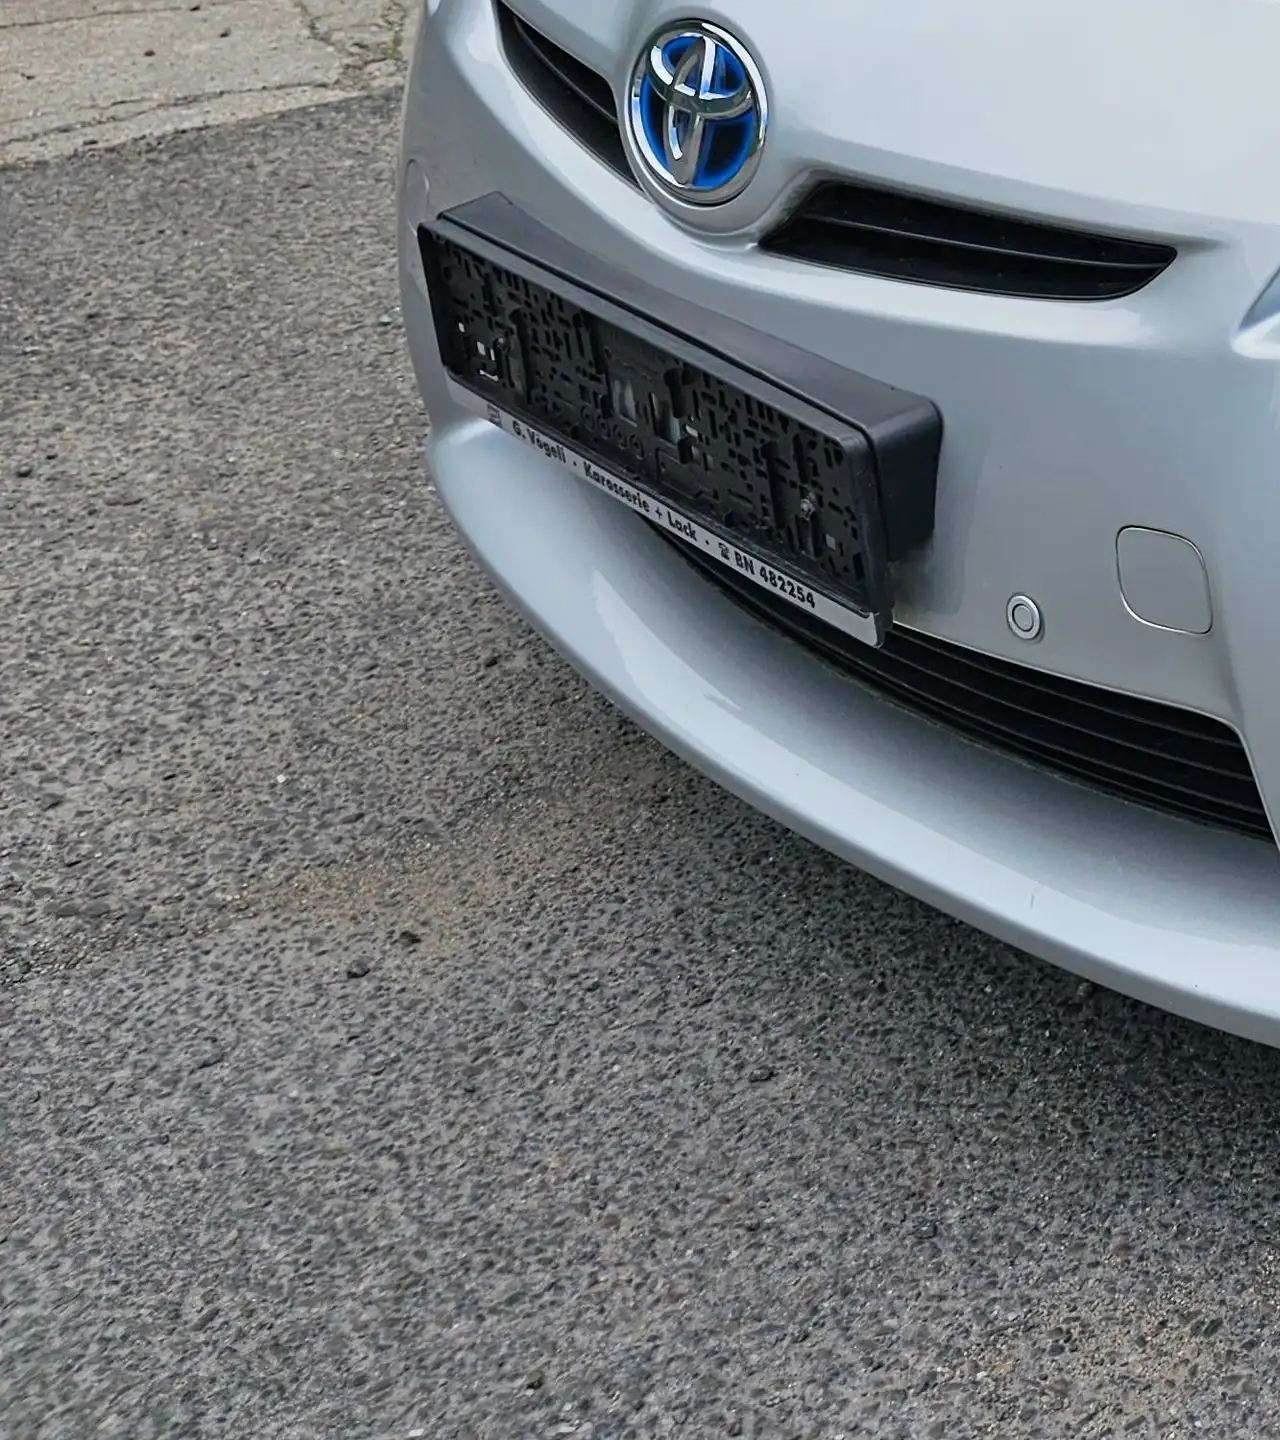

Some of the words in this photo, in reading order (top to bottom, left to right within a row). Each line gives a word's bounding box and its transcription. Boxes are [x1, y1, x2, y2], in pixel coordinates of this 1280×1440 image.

[511, 419, 527, 440] G.
[583, 461, 650, 513] Karosserie
[667, 509, 698, 542] Lack
[734, 550, 756, 576] BN
[759, 566, 817, 609] 482254
